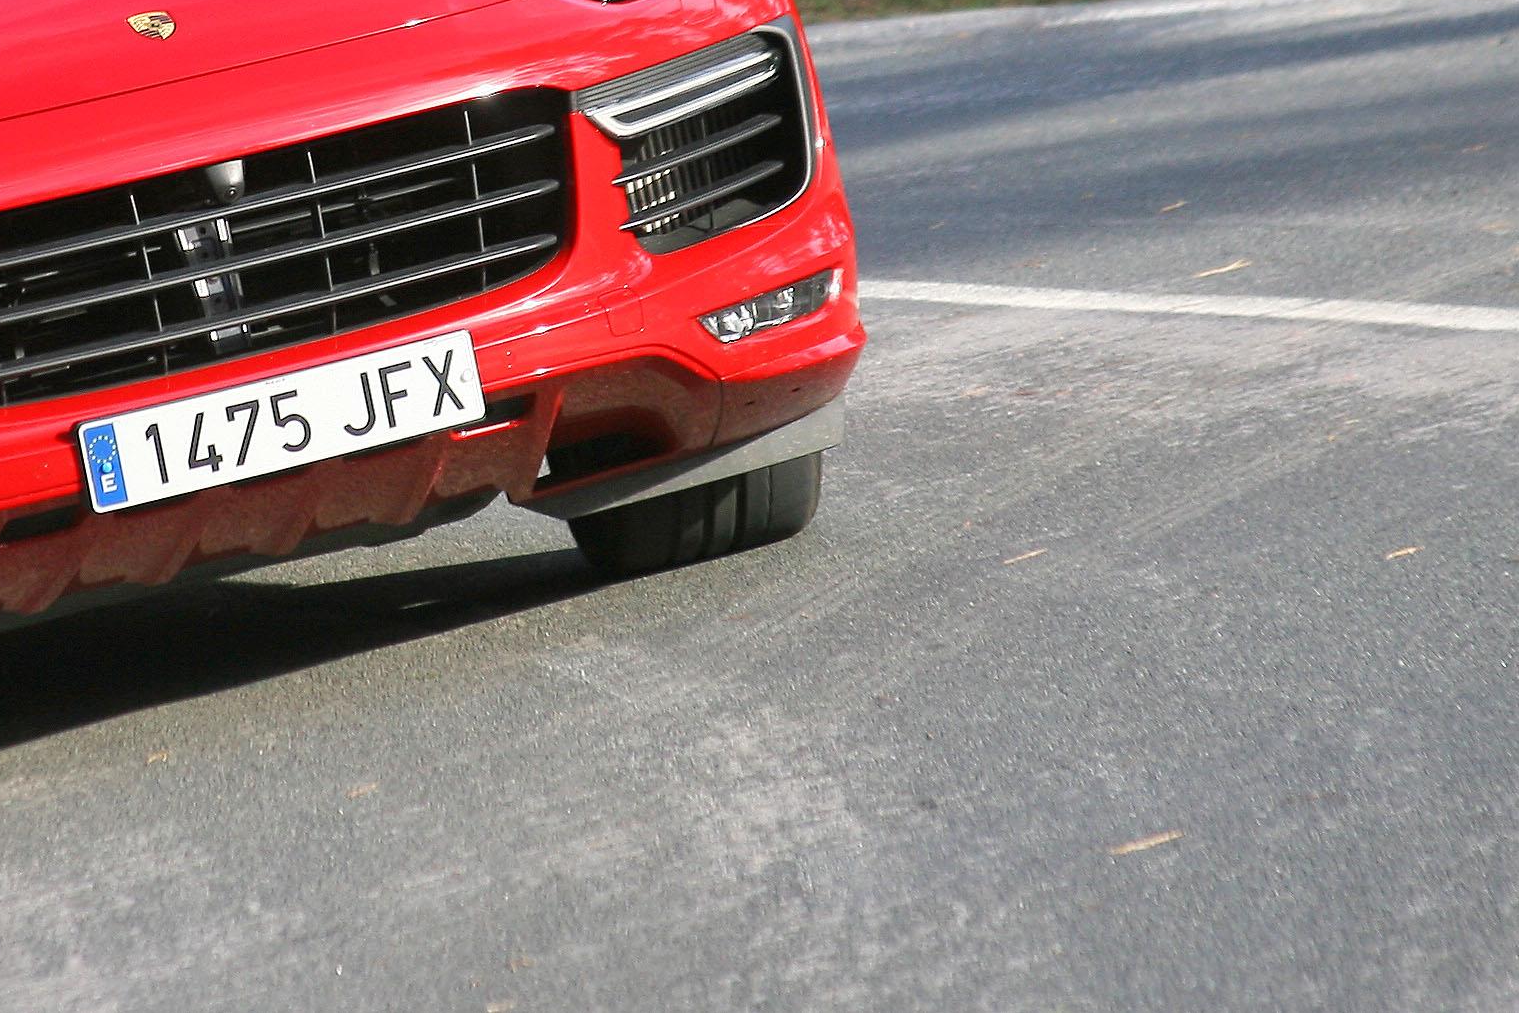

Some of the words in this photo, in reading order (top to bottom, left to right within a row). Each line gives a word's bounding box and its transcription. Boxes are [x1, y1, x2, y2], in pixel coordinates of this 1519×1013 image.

[144, 389, 312, 485] 1475
[343, 348, 465, 437] JFX
[100, 472, 119, 494] E
